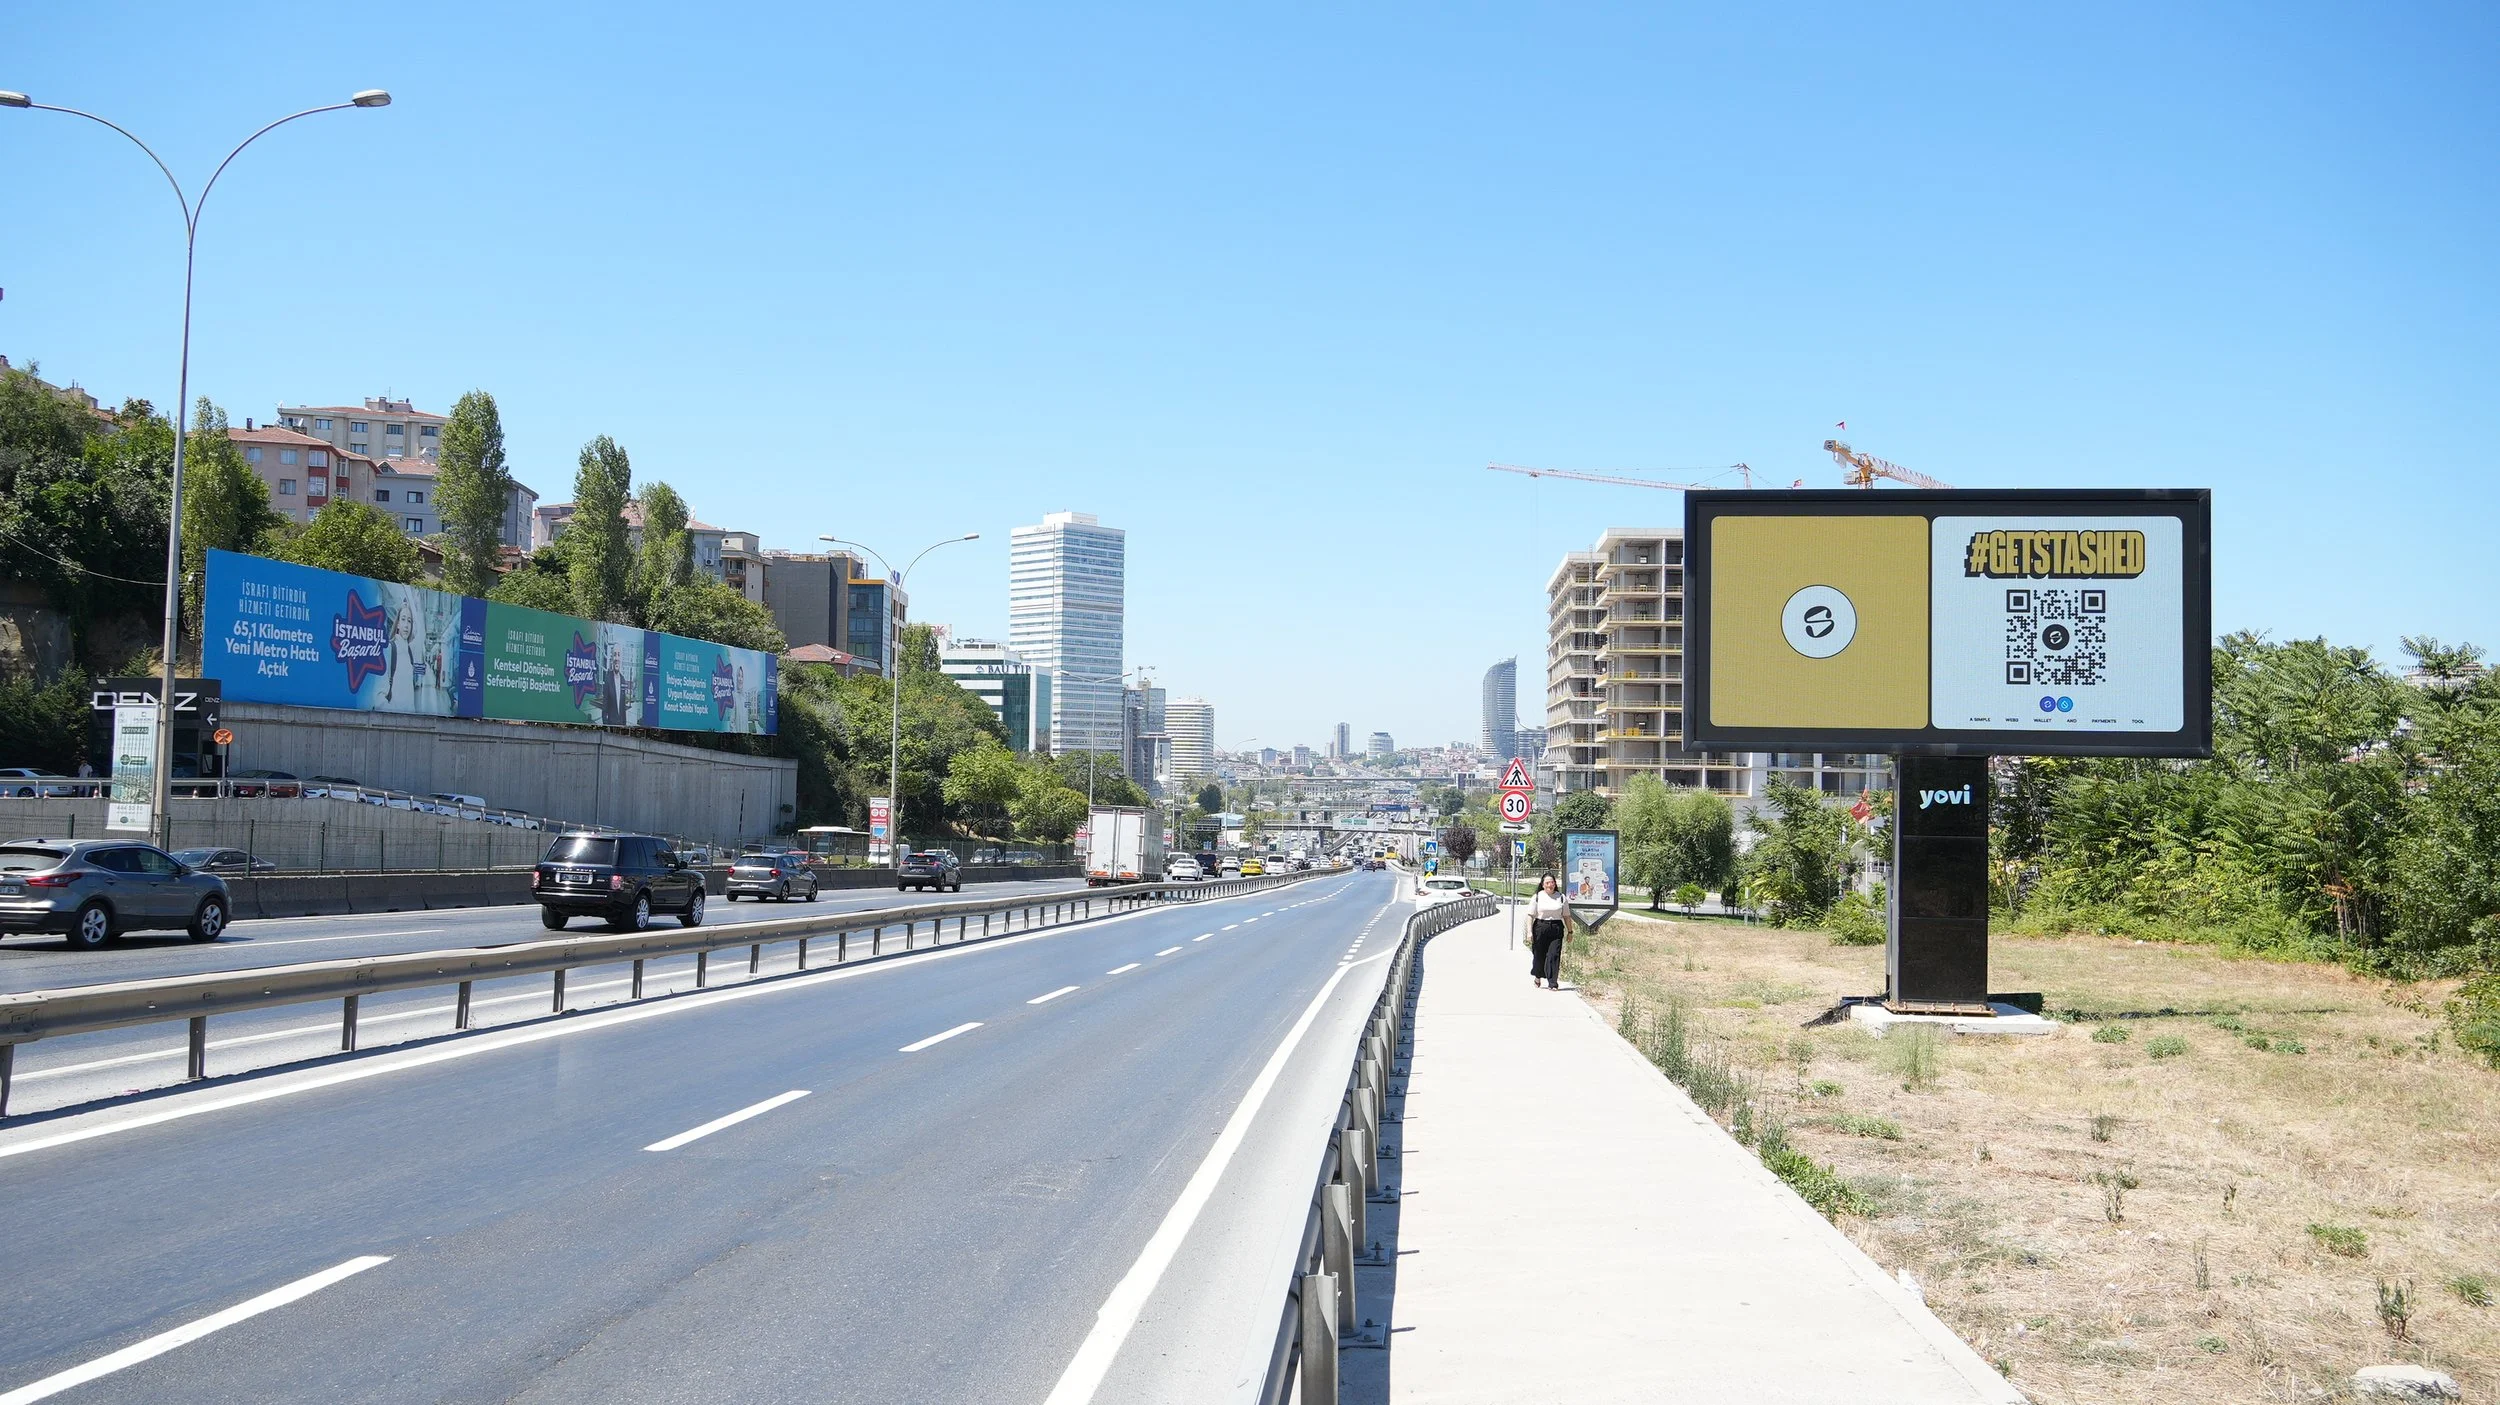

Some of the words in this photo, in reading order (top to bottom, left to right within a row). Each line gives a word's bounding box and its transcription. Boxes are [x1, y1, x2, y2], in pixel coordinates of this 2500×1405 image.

[1965, 530, 2145, 578] #GETSTASHED
[233, 620, 256, 637] 65,1
[259, 622, 313, 644] Kilometre
[335, 619, 387, 643] İSTANBUL
[225, 637, 251, 656] Yeni
[253, 640, 288, 659] Metro
[290, 644, 320, 662] Hattı
[337, 638, 382, 660] Başardı
[257, 660, 289, 679] Açtık
[494, 658, 522, 673] Kentsel
[523, 661, 555, 678] Dönüşüm
[566, 653, 597, 670] İSTANBUL
[988, 665, 1009, 674] BAU
[486, 673, 528, 692] Seferberliği
[530, 679, 560, 693] Başlattık
[1506, 798, 1524, 813] 30
[1919, 784, 1970, 810] yovi
